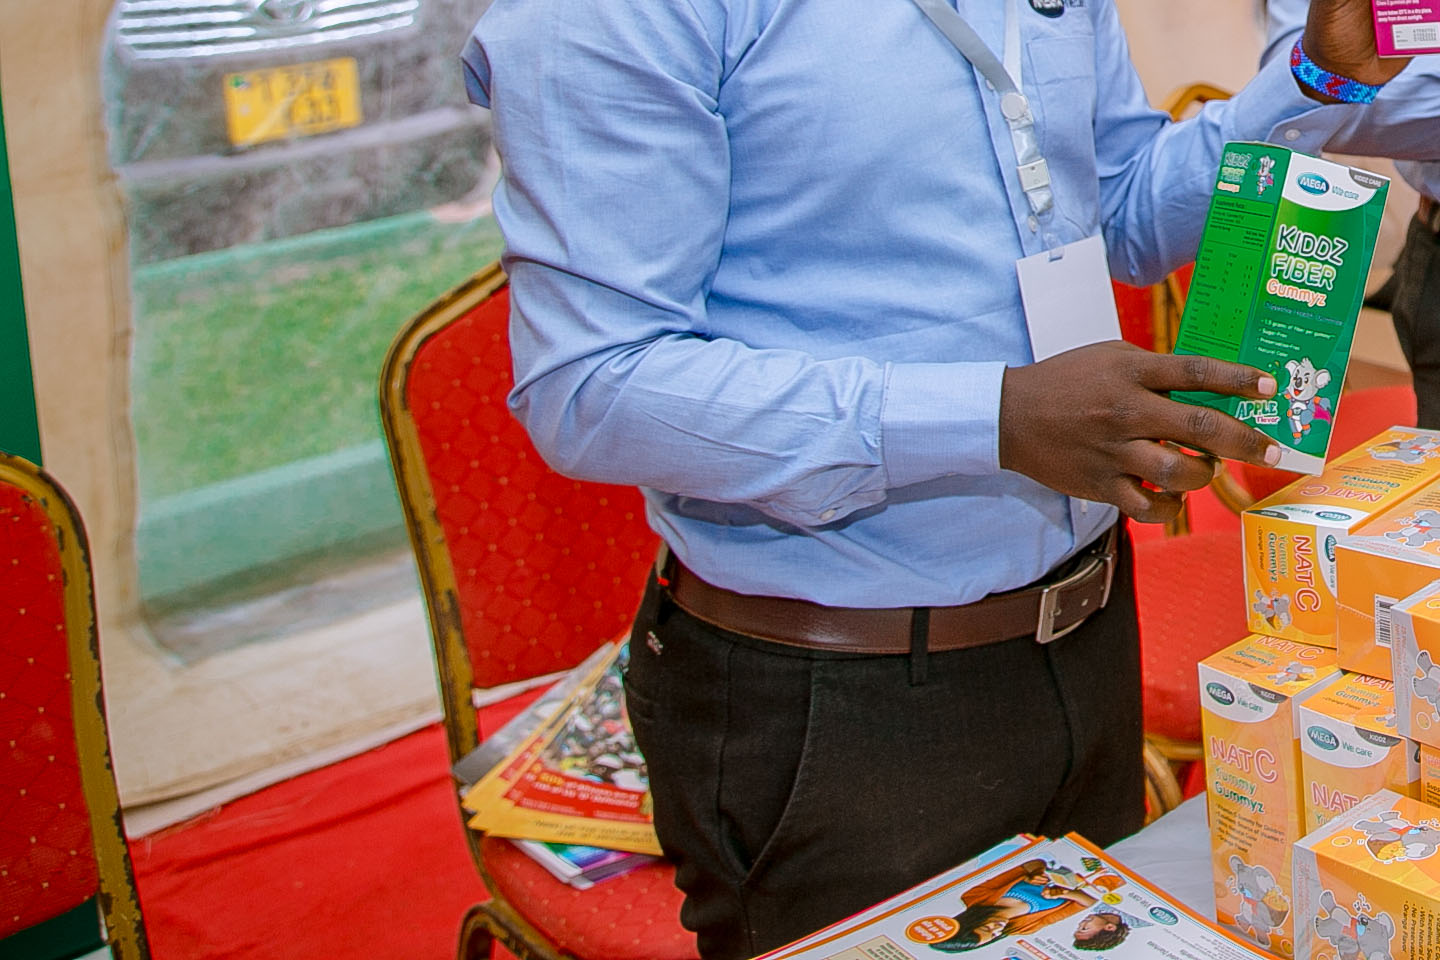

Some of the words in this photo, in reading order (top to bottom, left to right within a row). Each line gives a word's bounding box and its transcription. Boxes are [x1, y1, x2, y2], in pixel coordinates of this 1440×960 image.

[1300, 176, 1327, 191] MEGA
[1277, 224, 1348, 265] KIDDZ
[1271, 253, 1336, 290] FIBER
[1266, 279, 1327, 307] Gummyz
[1236, 401, 1278, 420] APPLE
[1300, 484, 1328, 498] C
[1334, 486, 1386, 503] NAT
[1268, 532, 1278, 583] Gummyz
[1293, 534, 1314, 588] NAT
[1296, 587, 1322, 612] C
[1254, 636, 1300, 654] NAT
[1296, 646, 1325, 660] C
[1208, 686, 1233, 702] MEGA
[1310, 730, 1336, 746] MEGA
[1342, 740, 1354, 752] We
[1356, 747, 1372, 758] care
[1210, 736, 1252, 772] NAT
[1254, 748, 1278, 783] C
[1215, 780, 1264, 814] Gummyz
[1312, 782, 1360, 812] NAT
[1150, 908, 1175, 924] MEGA
[1402, 904, 1410, 927] Orange
[1411, 907, 1418, 918] No
